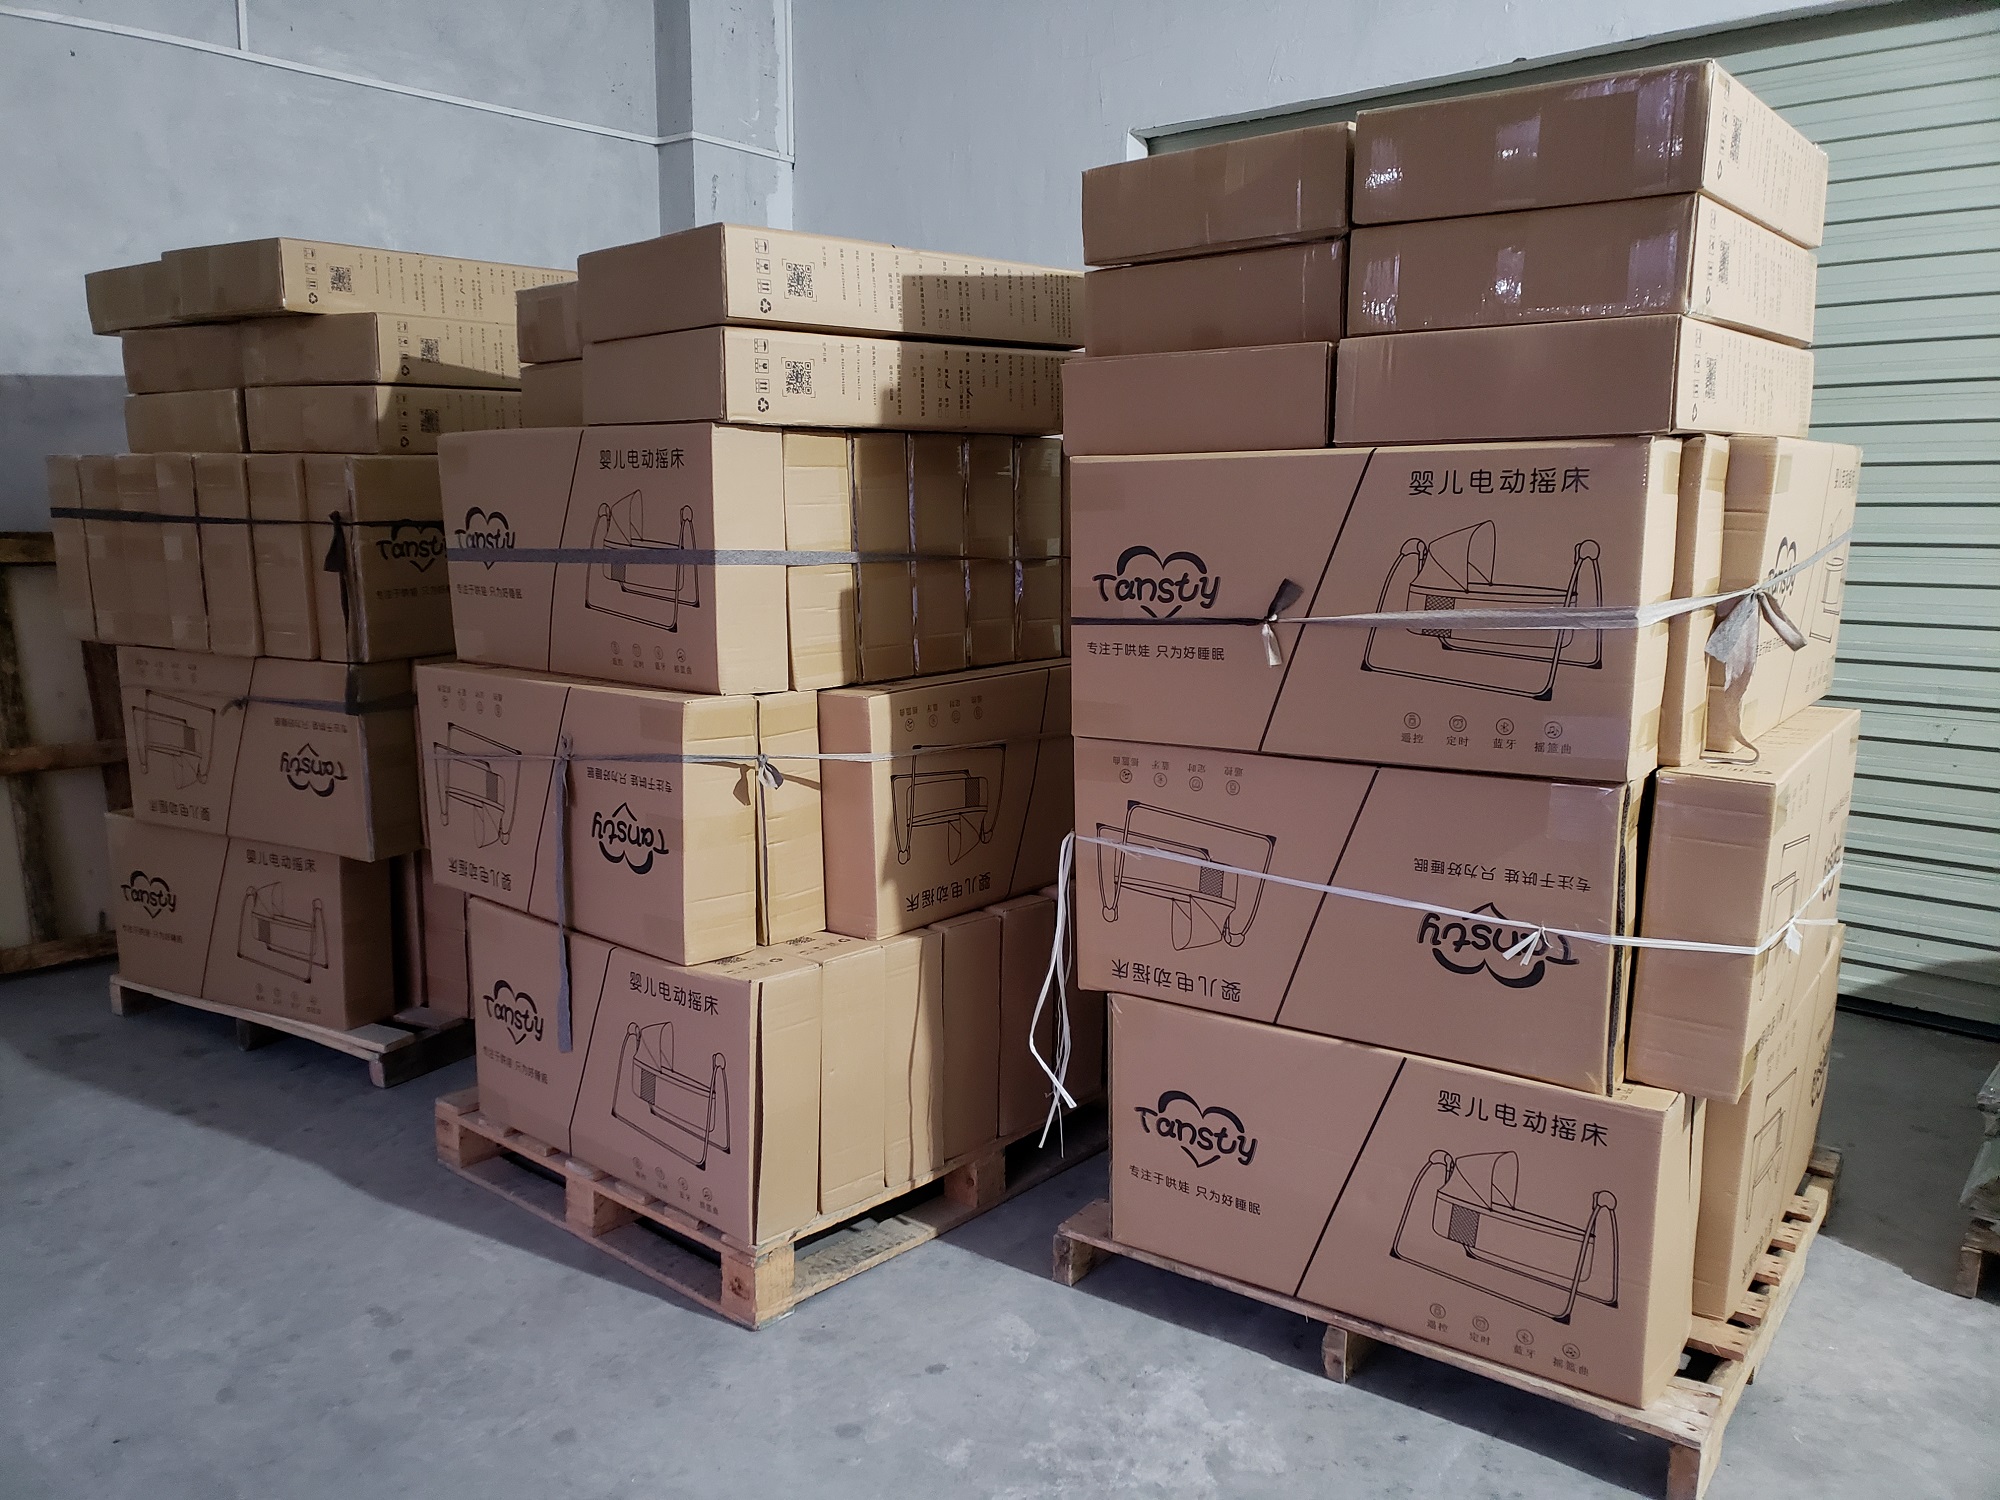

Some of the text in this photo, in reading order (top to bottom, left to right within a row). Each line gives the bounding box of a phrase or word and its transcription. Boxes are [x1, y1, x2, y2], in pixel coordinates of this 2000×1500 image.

[599, 448, 685, 470] 婴儿电动摇床
[1409, 466, 1590, 495] 婴儿电动摇床
[376, 533, 447, 560] Tanst
[1092, 572, 1221, 609] Tansty
[1087, 642, 1225, 661] 专注于哄娃 只为好睡眠
[1401, 732, 1424, 744] 遥控
[1446, 735, 1469, 747] 定时
[1493, 738, 1516, 750] 蓝牙
[1534, 741, 1572, 754] 摇篮曲
[280, 751, 348, 781] Tansty
[591, 812, 669, 854] Tansty
[448, 858, 512, 892] 婴儿电动摇床
[1414, 857, 1591, 892] 专注于哄娃 只为好睡眠
[121, 884, 177, 913] Tansty
[906, 872, 991, 912] 婴儿电动摇床
[629, 971, 719, 1016] 婴儿电动摇床
[1111, 959, 1241, 1002] 婴儿电动摇床
[483, 995, 544, 1041] Tansty
[1437, 1090, 1609, 1147] 婴儿电动摇床
[1134, 1107, 1258, 1165] Tansty
[1129, 1165, 1261, 1215] 专注于哄娃 只为好睡眠
